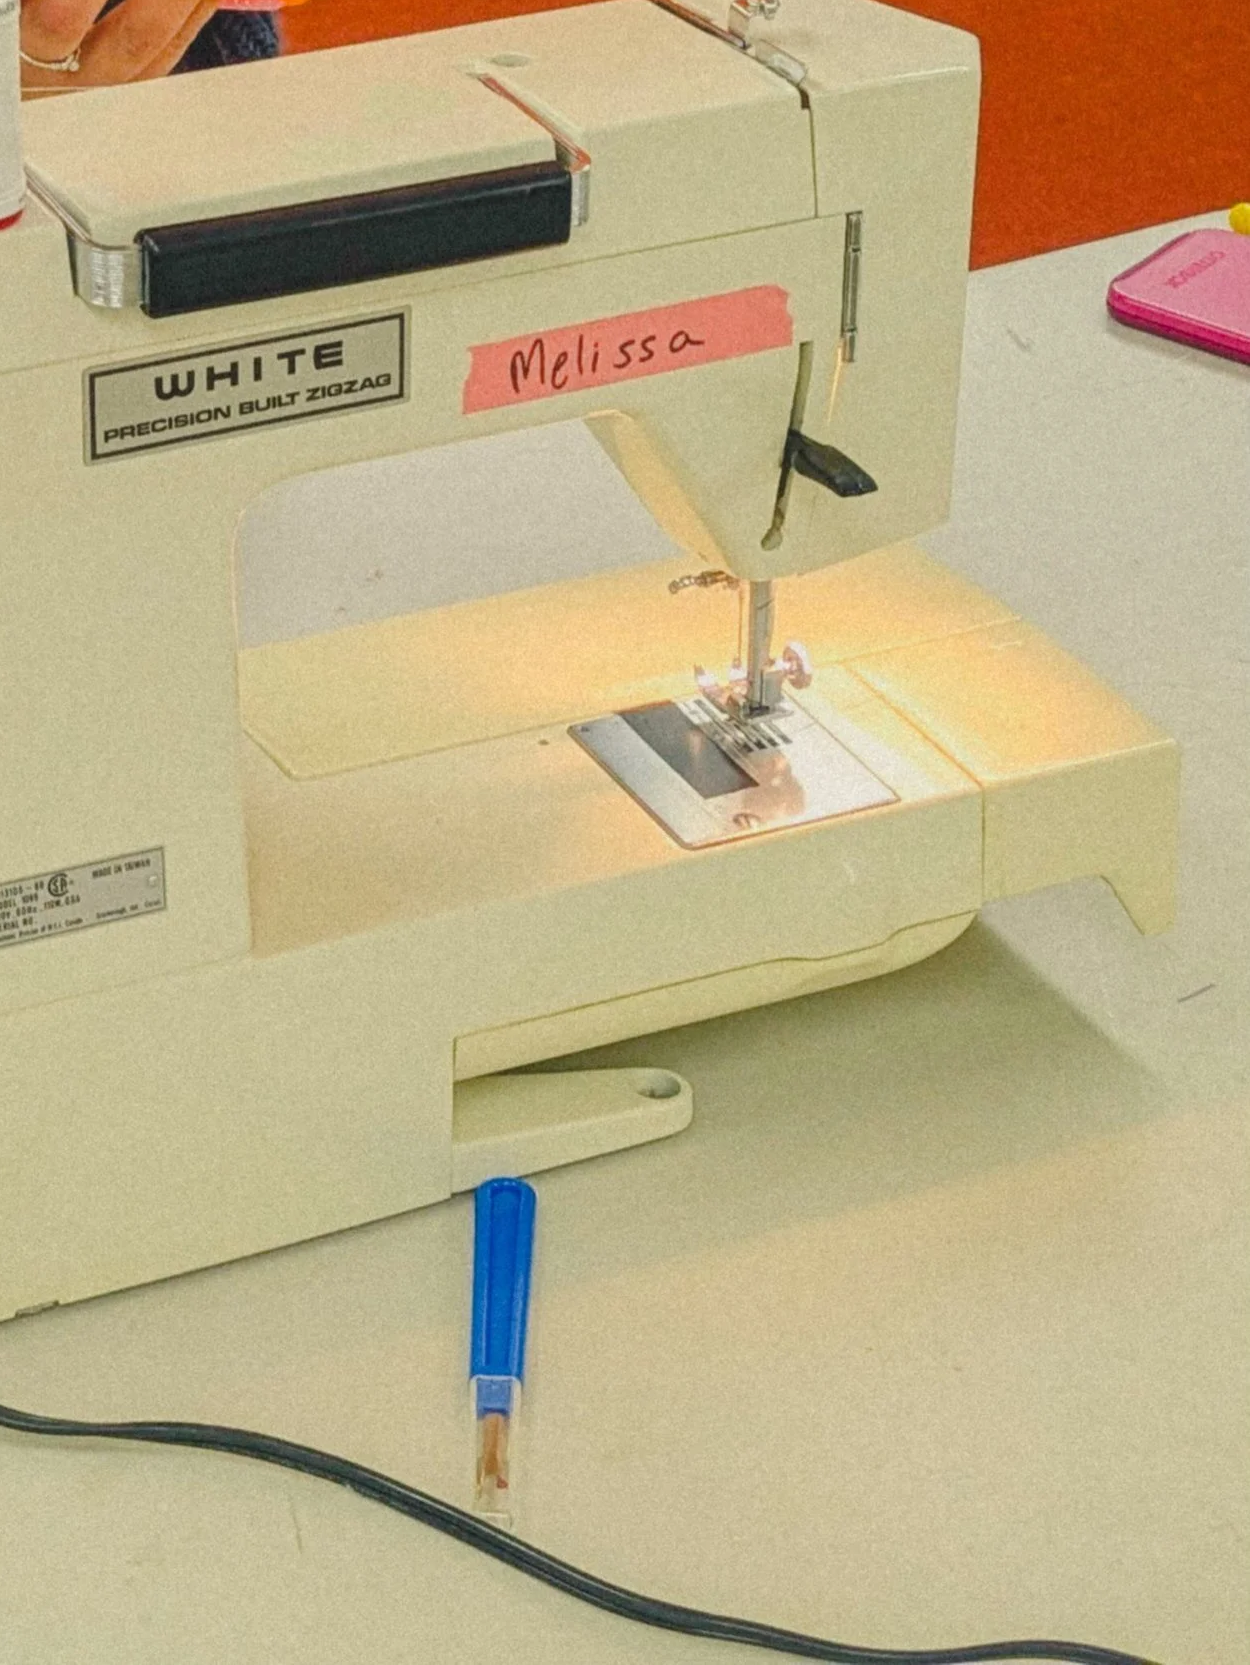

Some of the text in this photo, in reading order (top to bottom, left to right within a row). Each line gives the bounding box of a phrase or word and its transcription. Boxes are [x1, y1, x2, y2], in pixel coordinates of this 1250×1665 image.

[154, 340, 344, 401] WHITE
[509, 328, 705, 392] Melissa
[103, 372, 393, 444] PRECISION BUILT ZIGZAG
